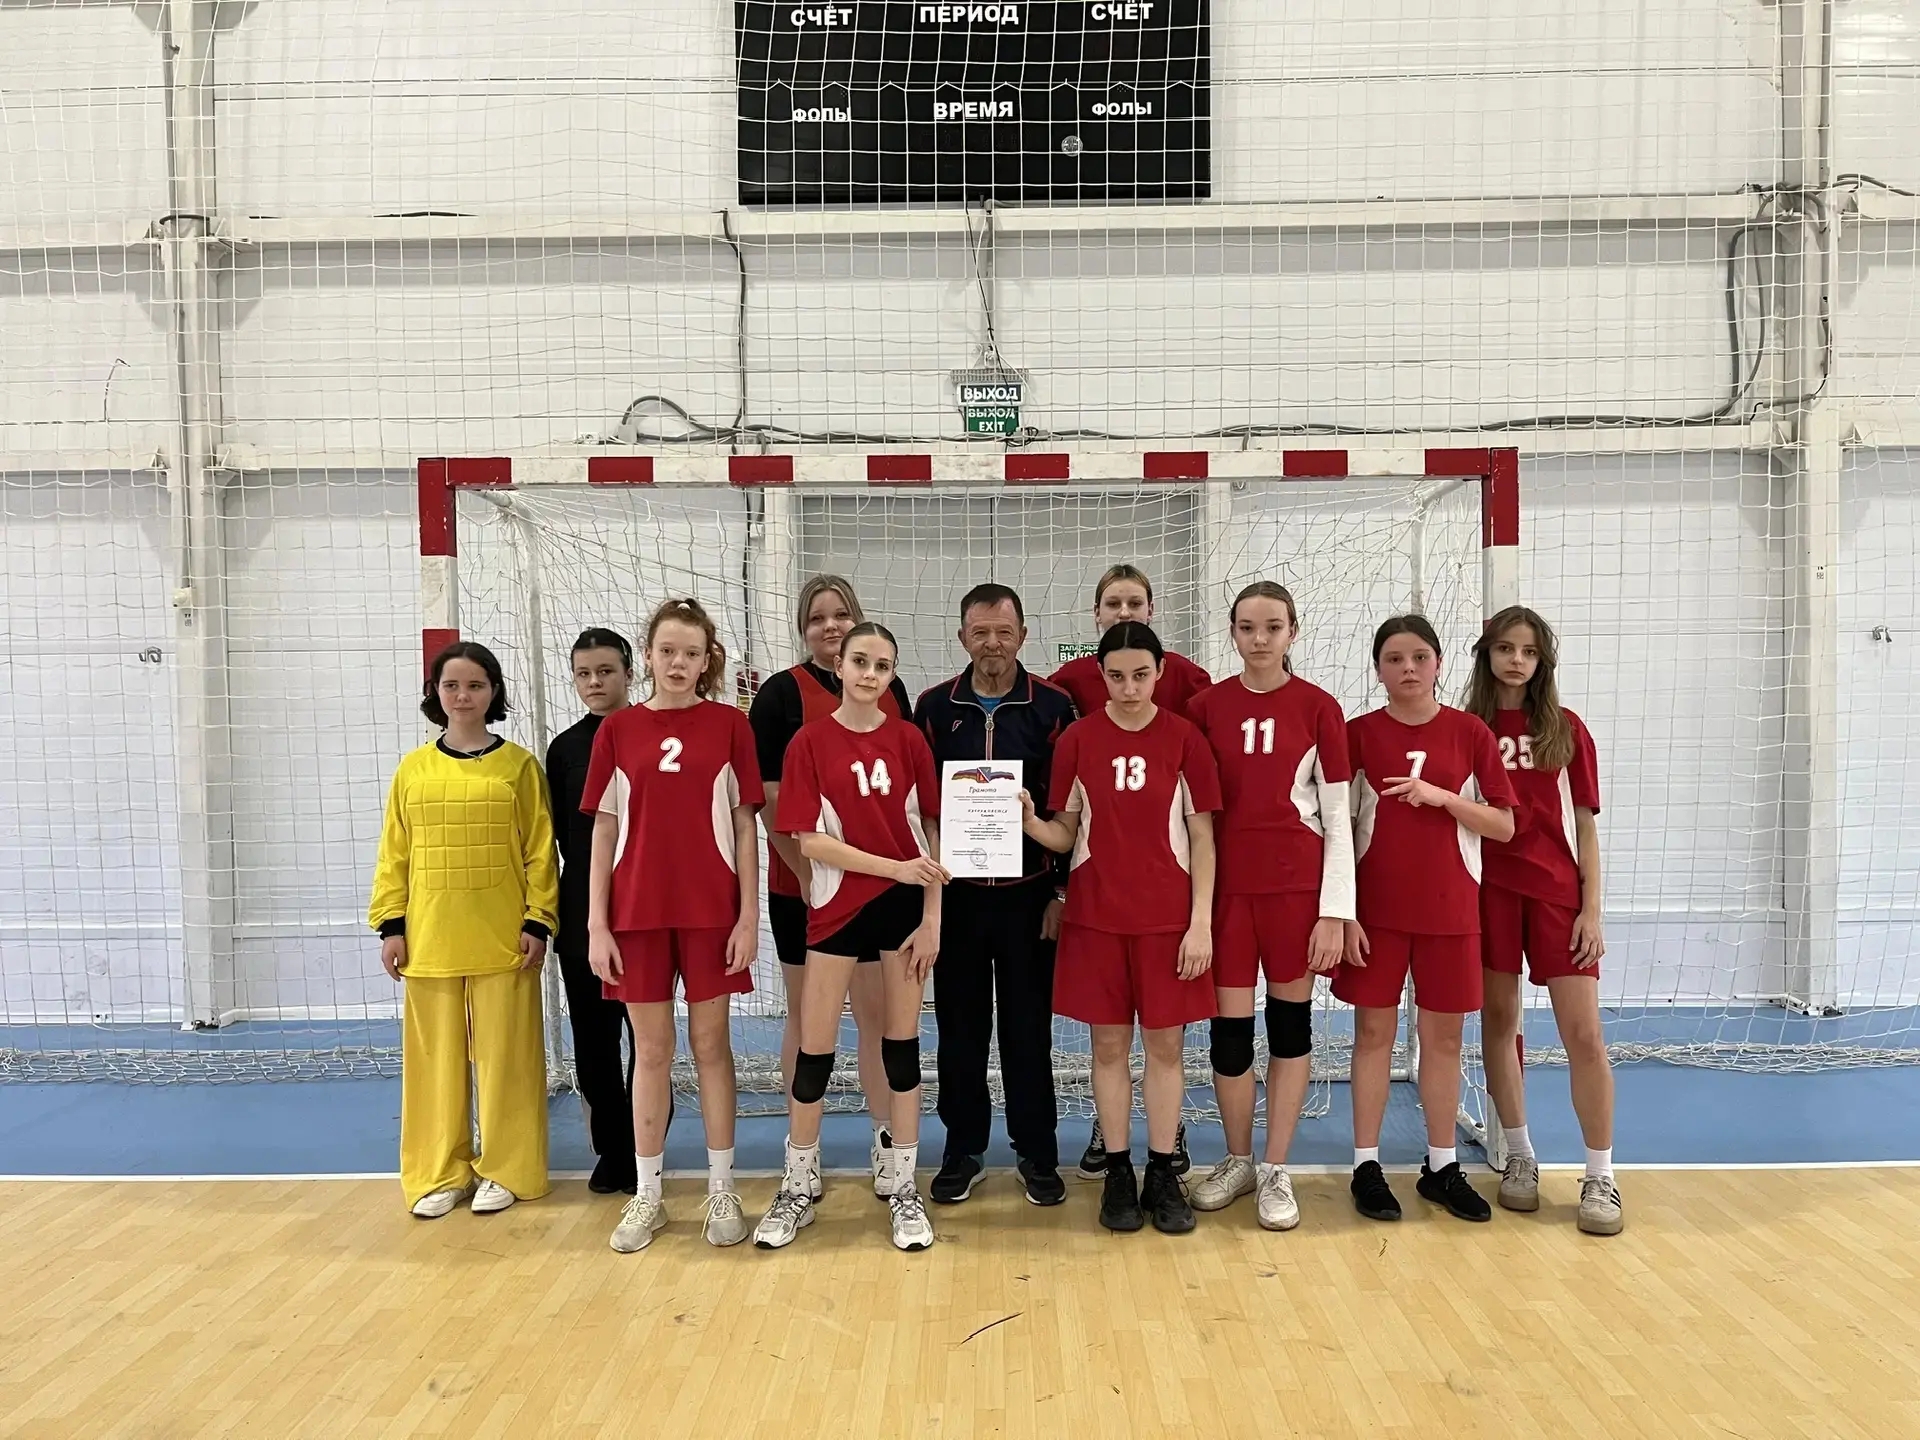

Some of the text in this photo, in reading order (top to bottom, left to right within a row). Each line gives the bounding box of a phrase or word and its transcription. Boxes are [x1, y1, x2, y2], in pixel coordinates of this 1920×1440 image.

[790, 5, 853, 27] СЧЁТ
[920, 5, 1019, 25] ПЕРИОД
[1091, 0, 1154, 21] СЧЁТ
[933, 101, 1014, 120] ВРЕМЯ
[1091, 101, 1152, 116] ФОЛЫ
[964, 387, 1018, 400] ВЫХОД
[968, 408, 1015, 419] ВЫХОД
[979, 421, 1005, 432] EXIT
[1240, 717, 1276, 755] 11
[658, 736, 684, 773] 2
[1498, 734, 1535, 771] 25
[1111, 755, 1147, 792] 13
[1405, 750, 1428, 779] 7
[850, 758, 892, 797] 14
